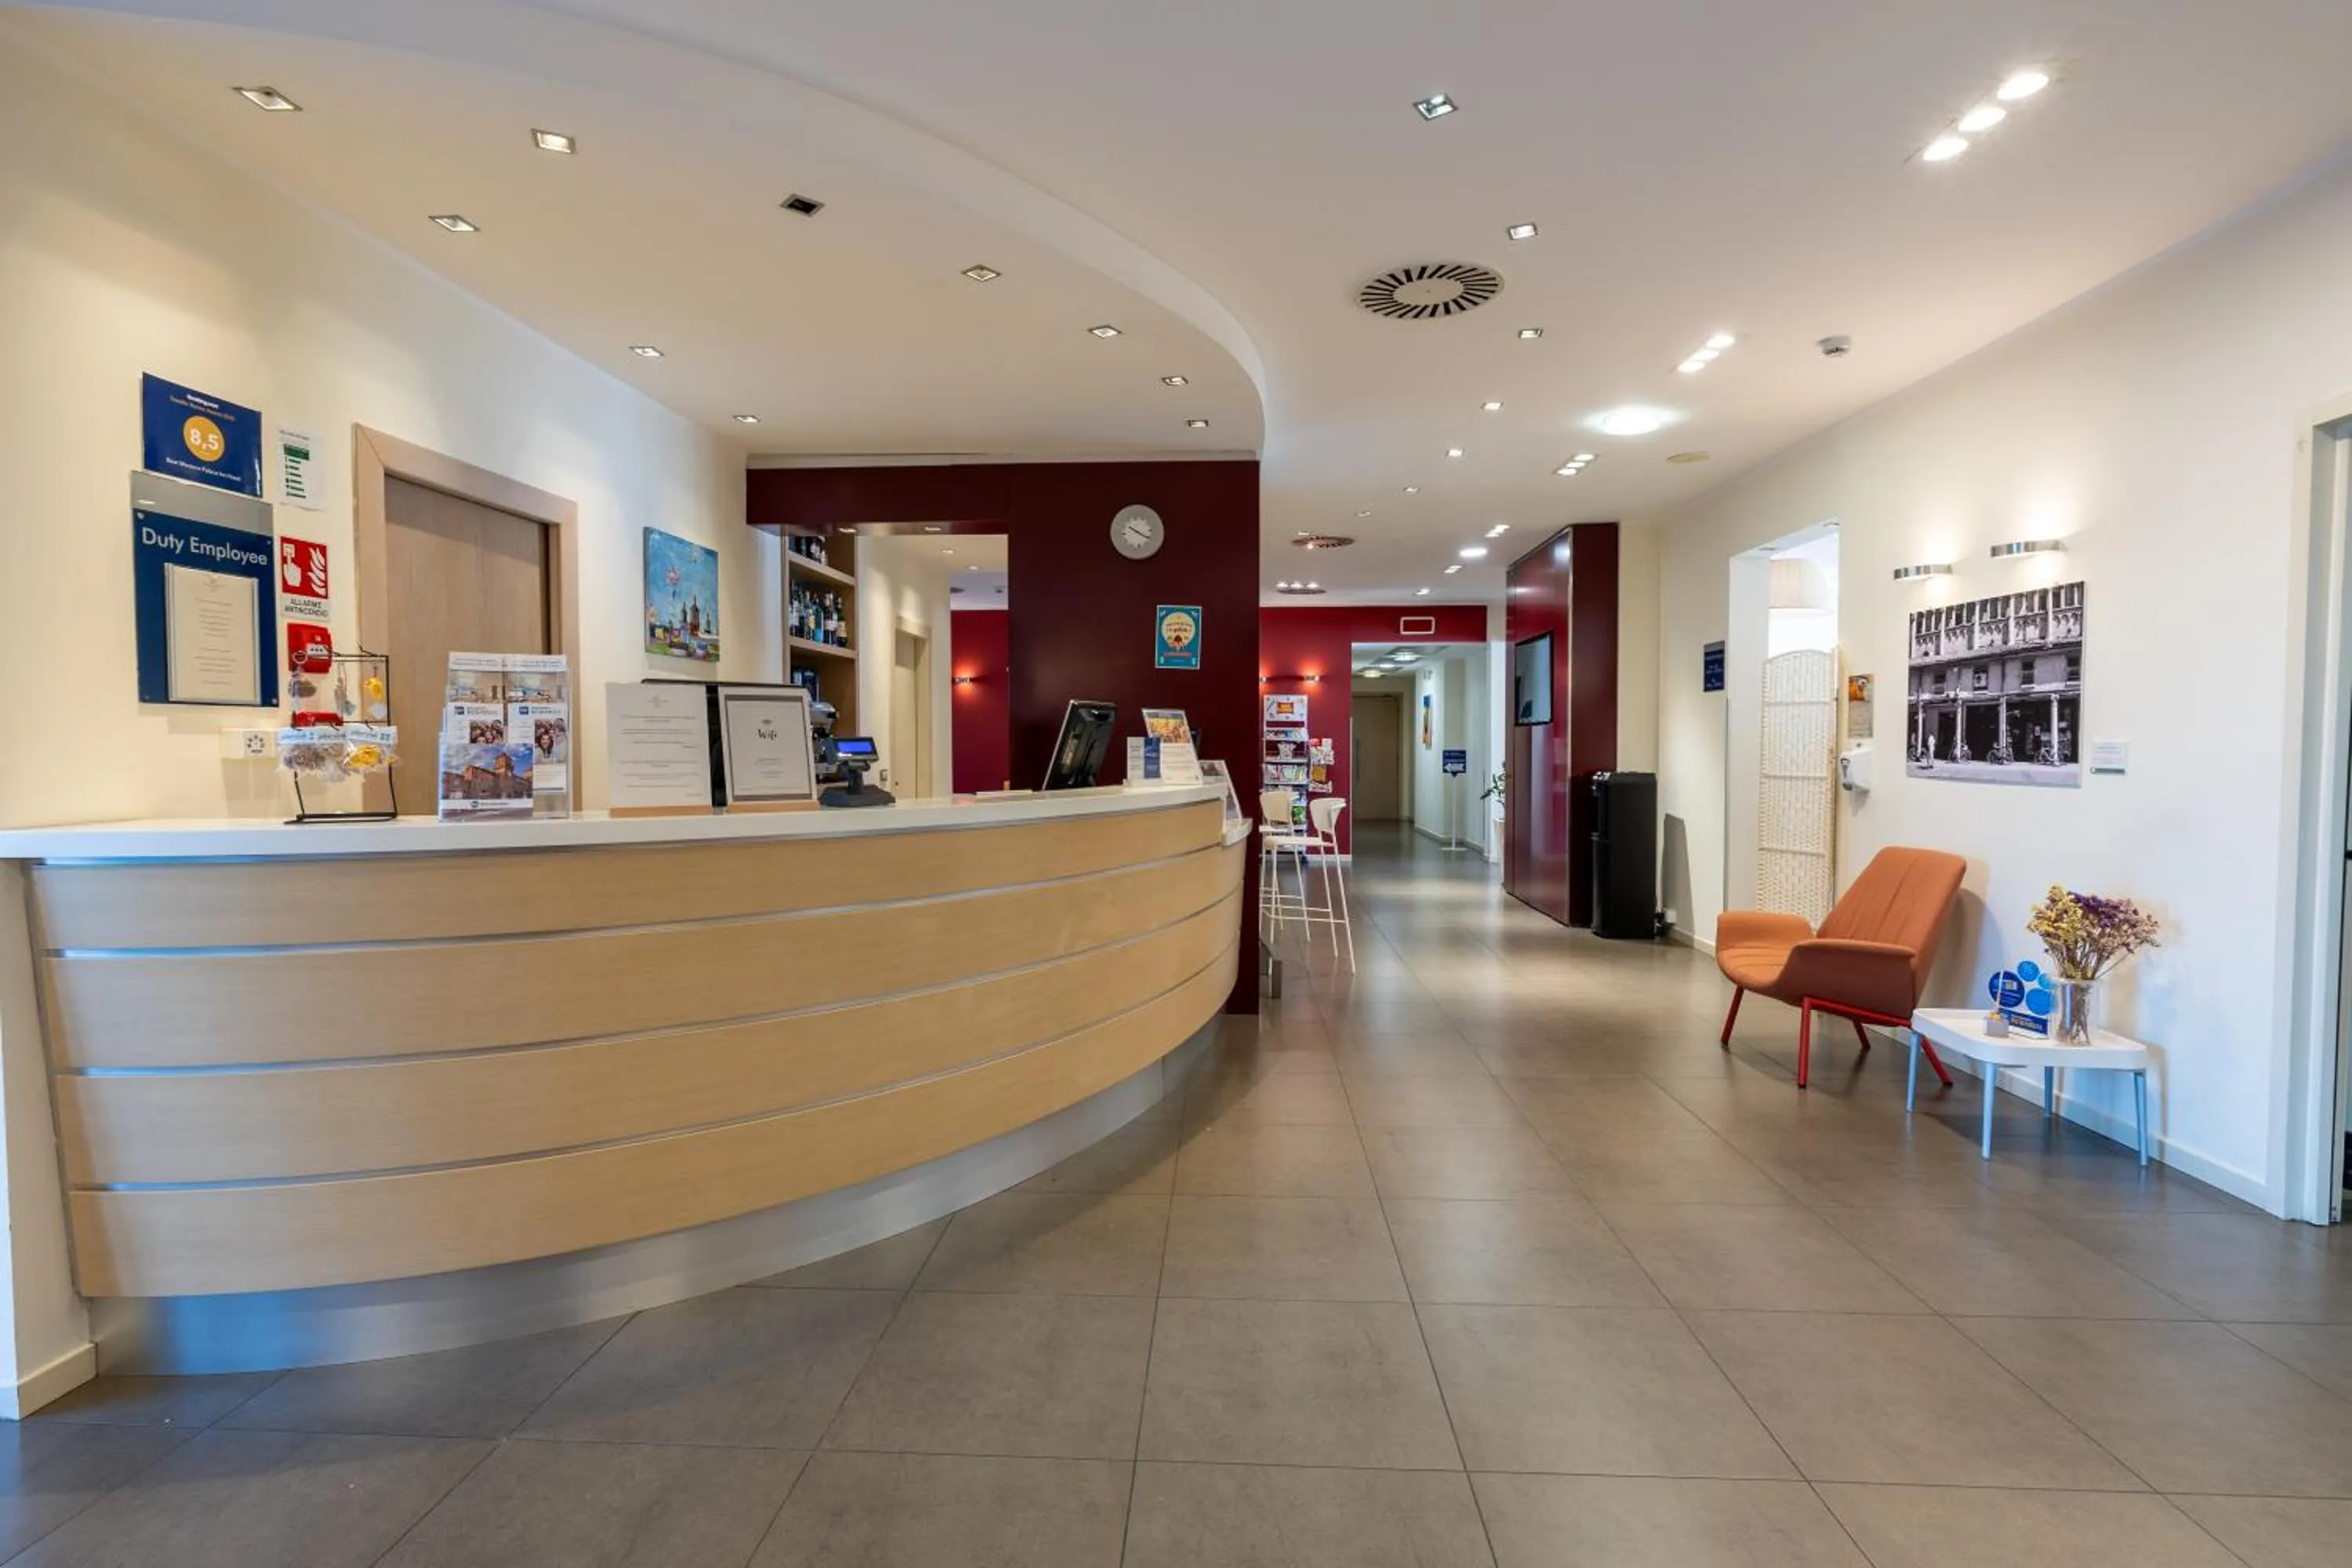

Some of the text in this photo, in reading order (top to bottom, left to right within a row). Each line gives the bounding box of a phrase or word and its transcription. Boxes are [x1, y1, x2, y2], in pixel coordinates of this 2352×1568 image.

[142, 526, 268, 565] Duty Employee
[290, 598, 322, 609] ALLARME
